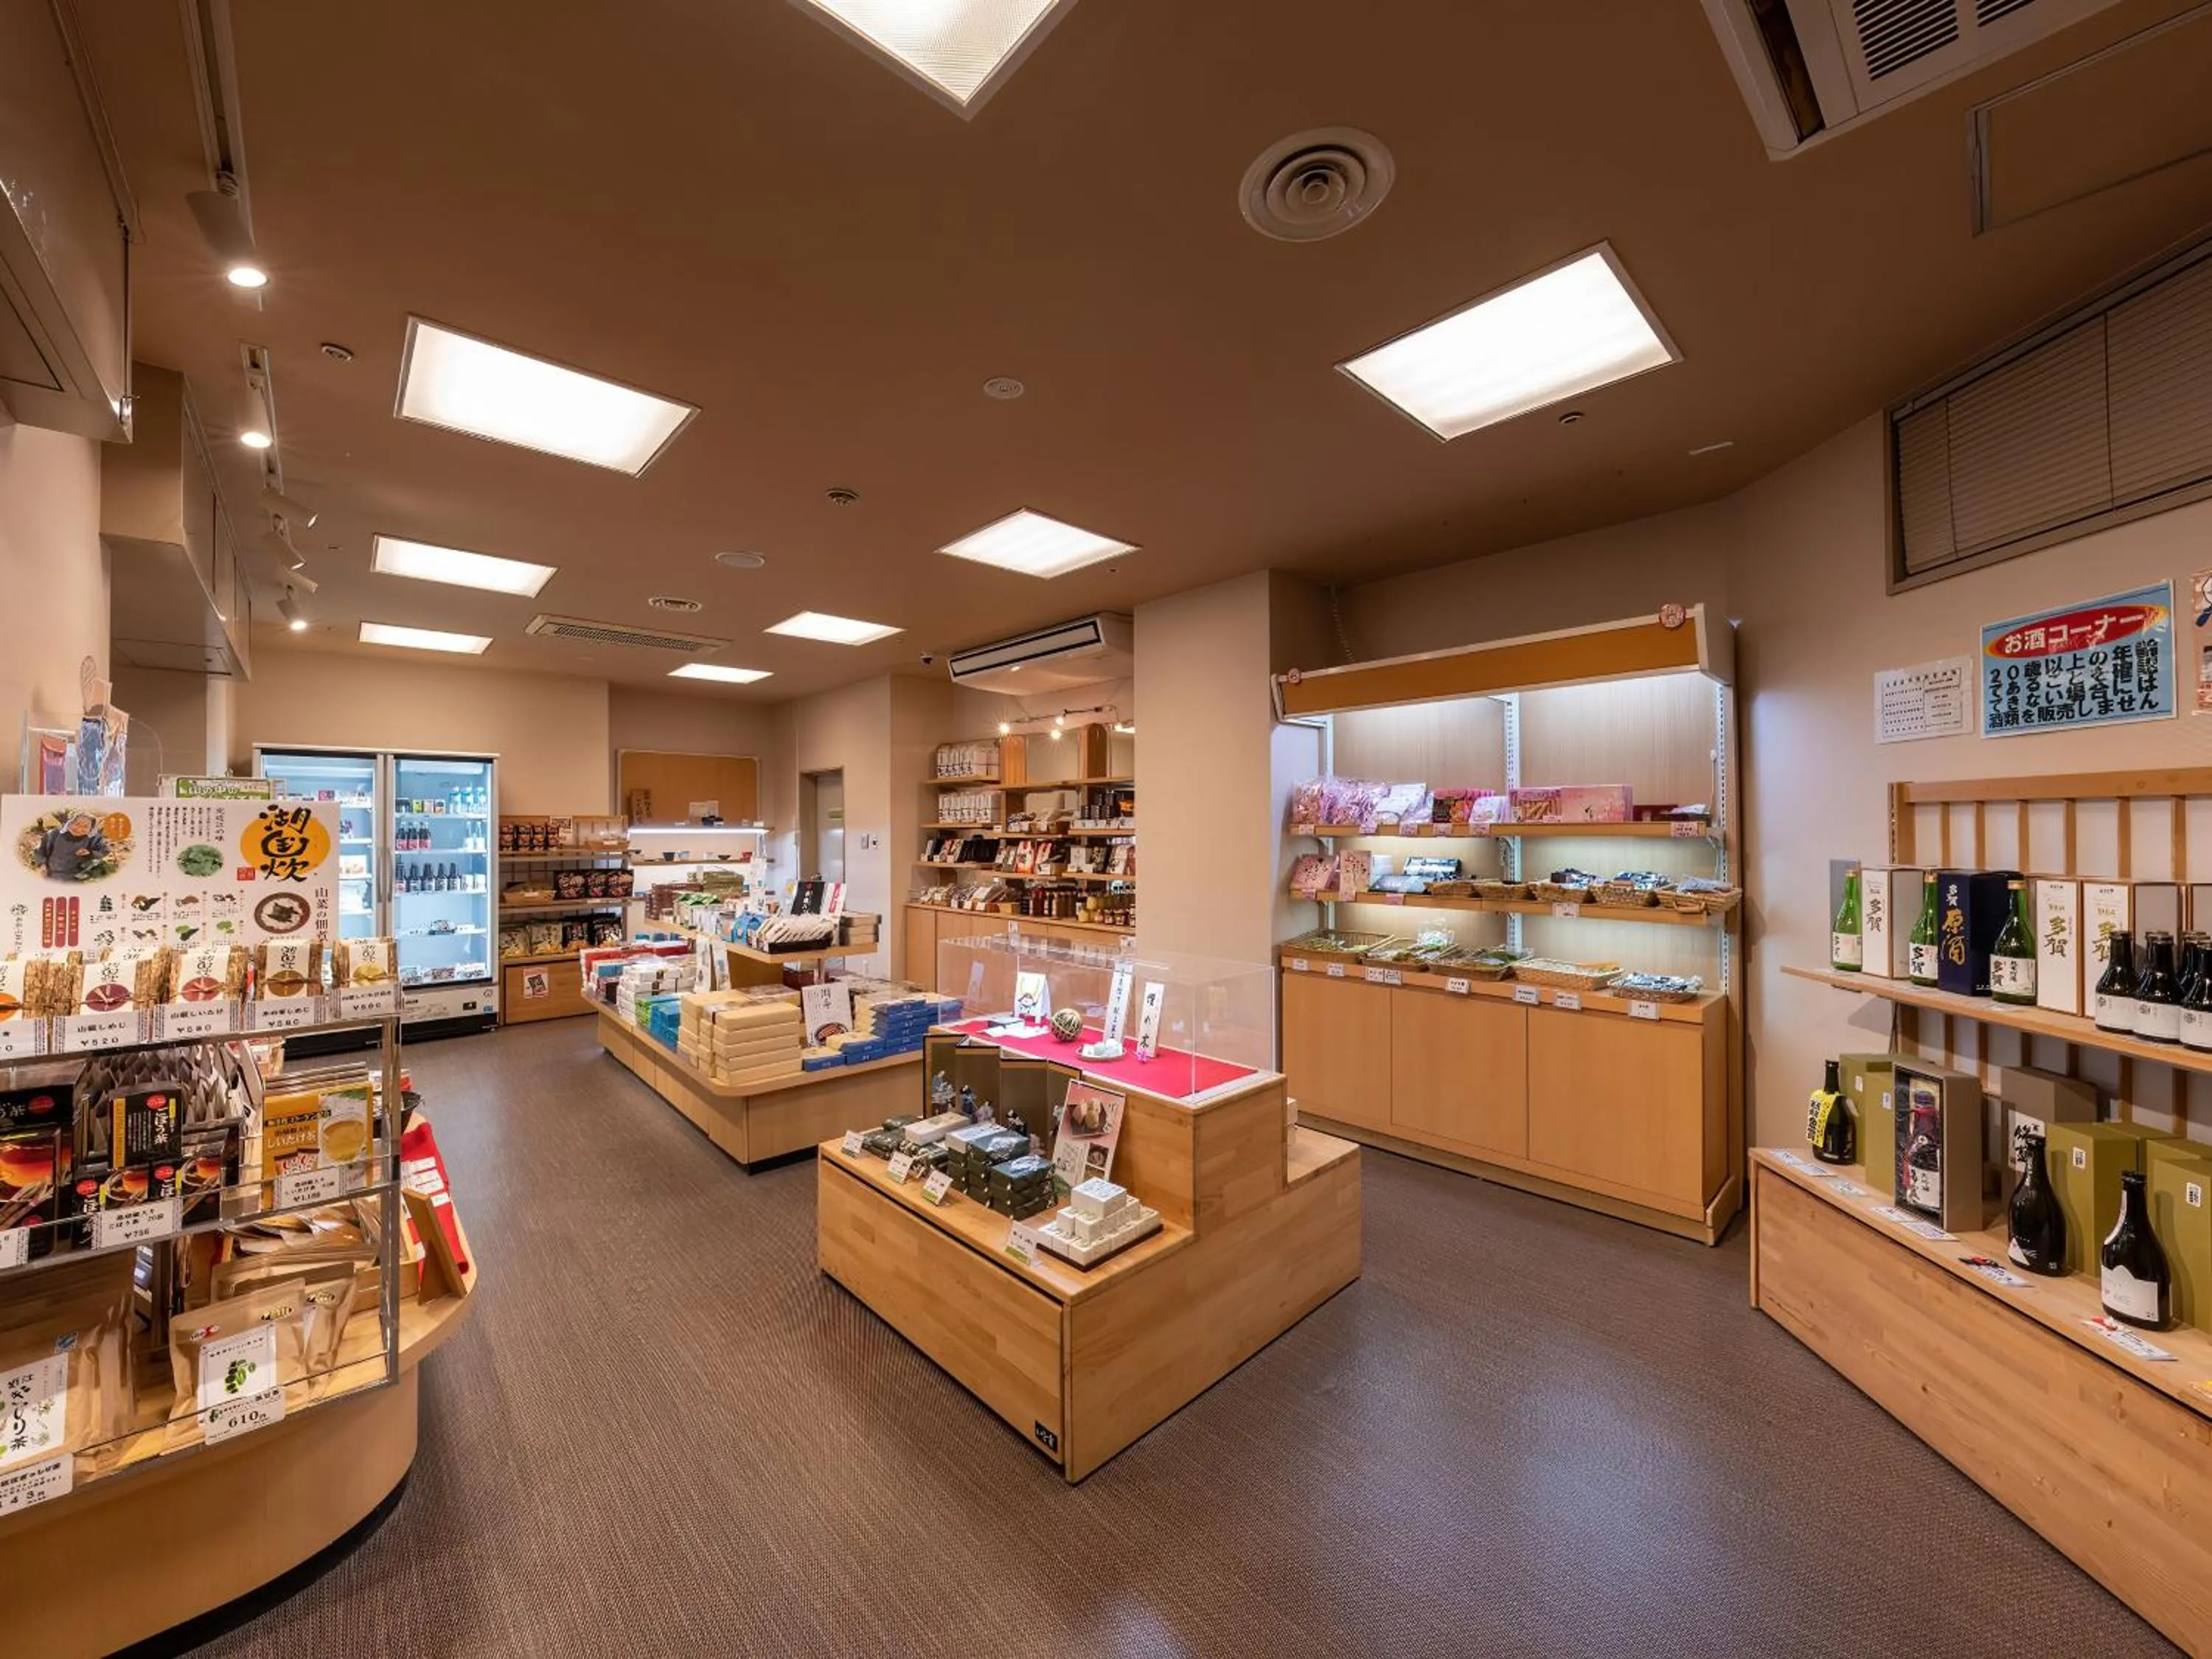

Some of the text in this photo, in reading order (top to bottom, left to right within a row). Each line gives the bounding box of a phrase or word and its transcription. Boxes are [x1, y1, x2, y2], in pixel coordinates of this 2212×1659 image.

[2005, 614, 2145, 654] お酒コーナー
[1989, 676, 2159, 712] できない場合には
[1989, 692, 2160, 728] 酒類を販売しません
[1865, 898, 1882, 932] 多賀
[1941, 908, 1965, 965] 原酒
[2043, 915, 2067, 958] 多賀
[1911, 946, 1924, 974] 多賀
